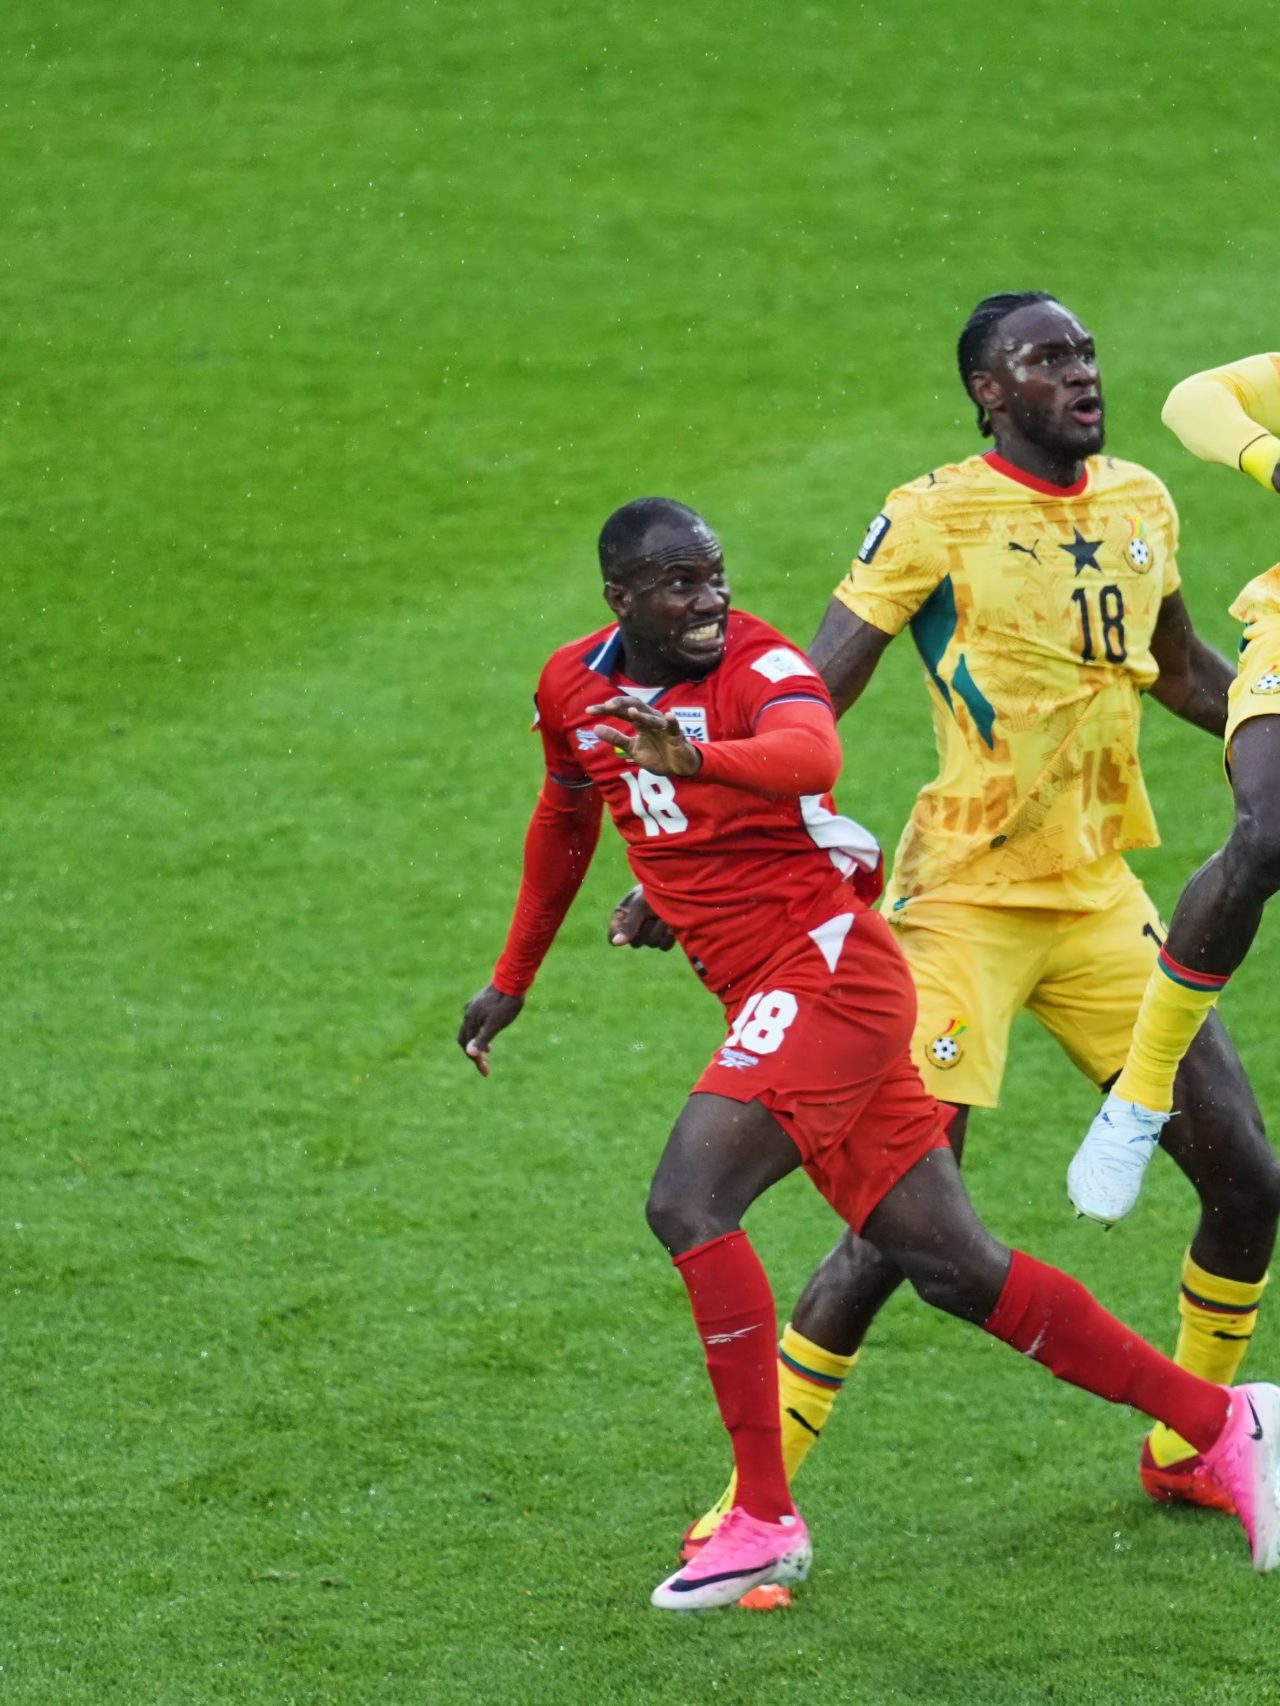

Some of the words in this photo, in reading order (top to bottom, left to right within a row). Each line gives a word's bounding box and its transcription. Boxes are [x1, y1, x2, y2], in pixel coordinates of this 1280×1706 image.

[1072, 585, 1128, 664] 18
[619, 768, 688, 836] 18
[724, 989, 799, 1055] 18
